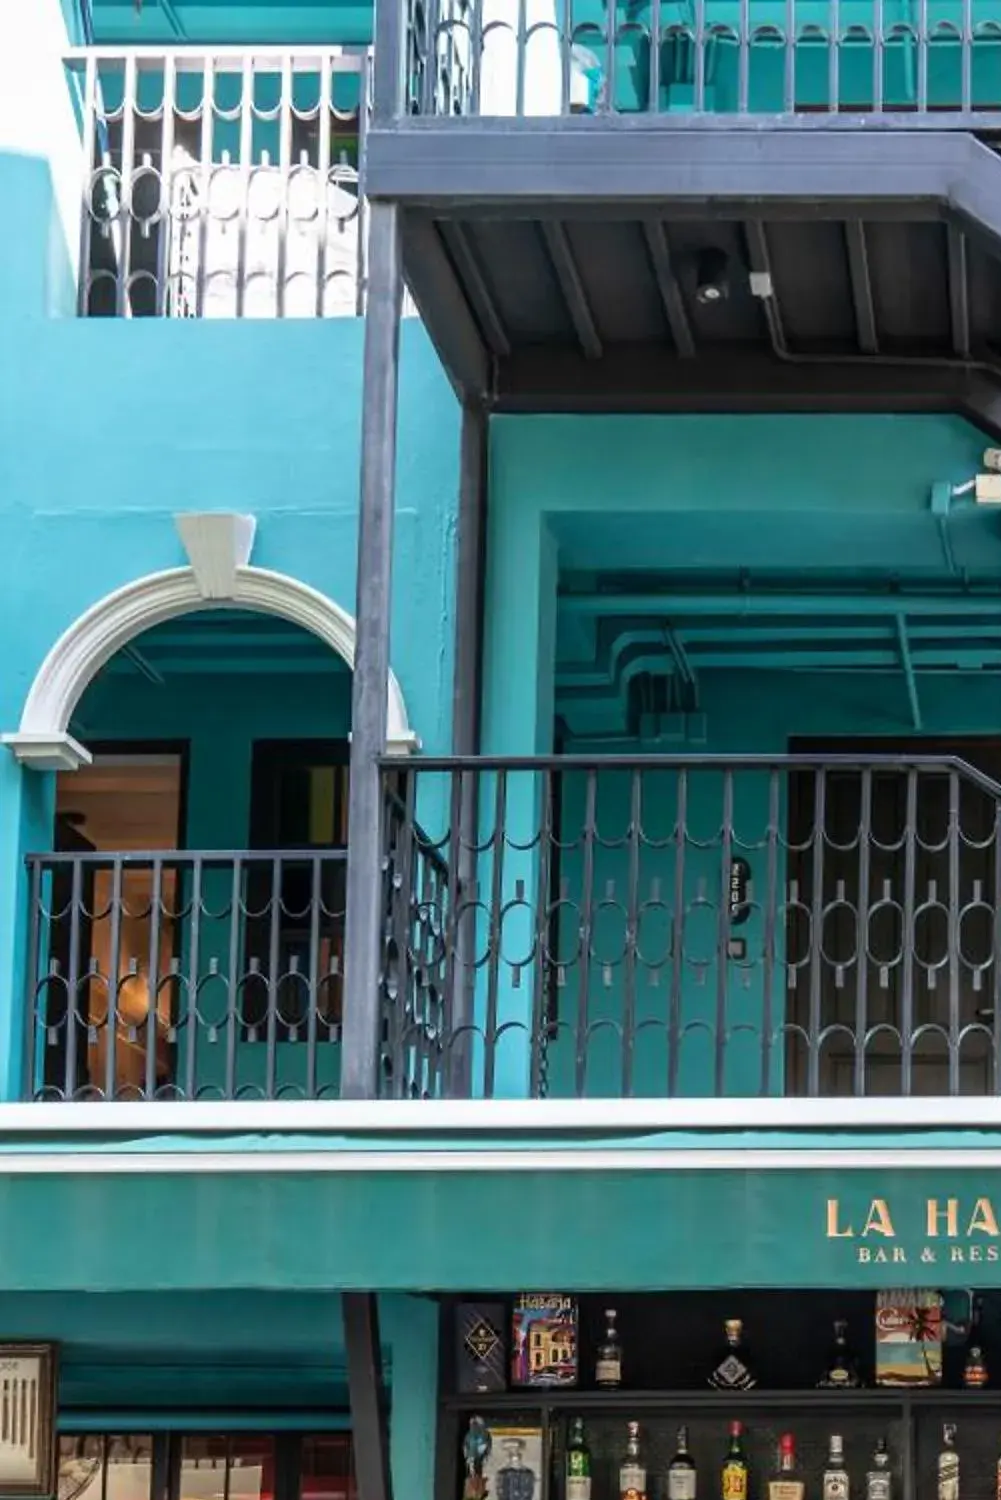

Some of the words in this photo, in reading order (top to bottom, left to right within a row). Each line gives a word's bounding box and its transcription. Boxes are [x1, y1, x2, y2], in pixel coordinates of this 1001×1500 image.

[826, 1198, 896, 1238] LA
[858, 1247, 907, 1263] BAR
[920, 1247, 936, 1263] &
